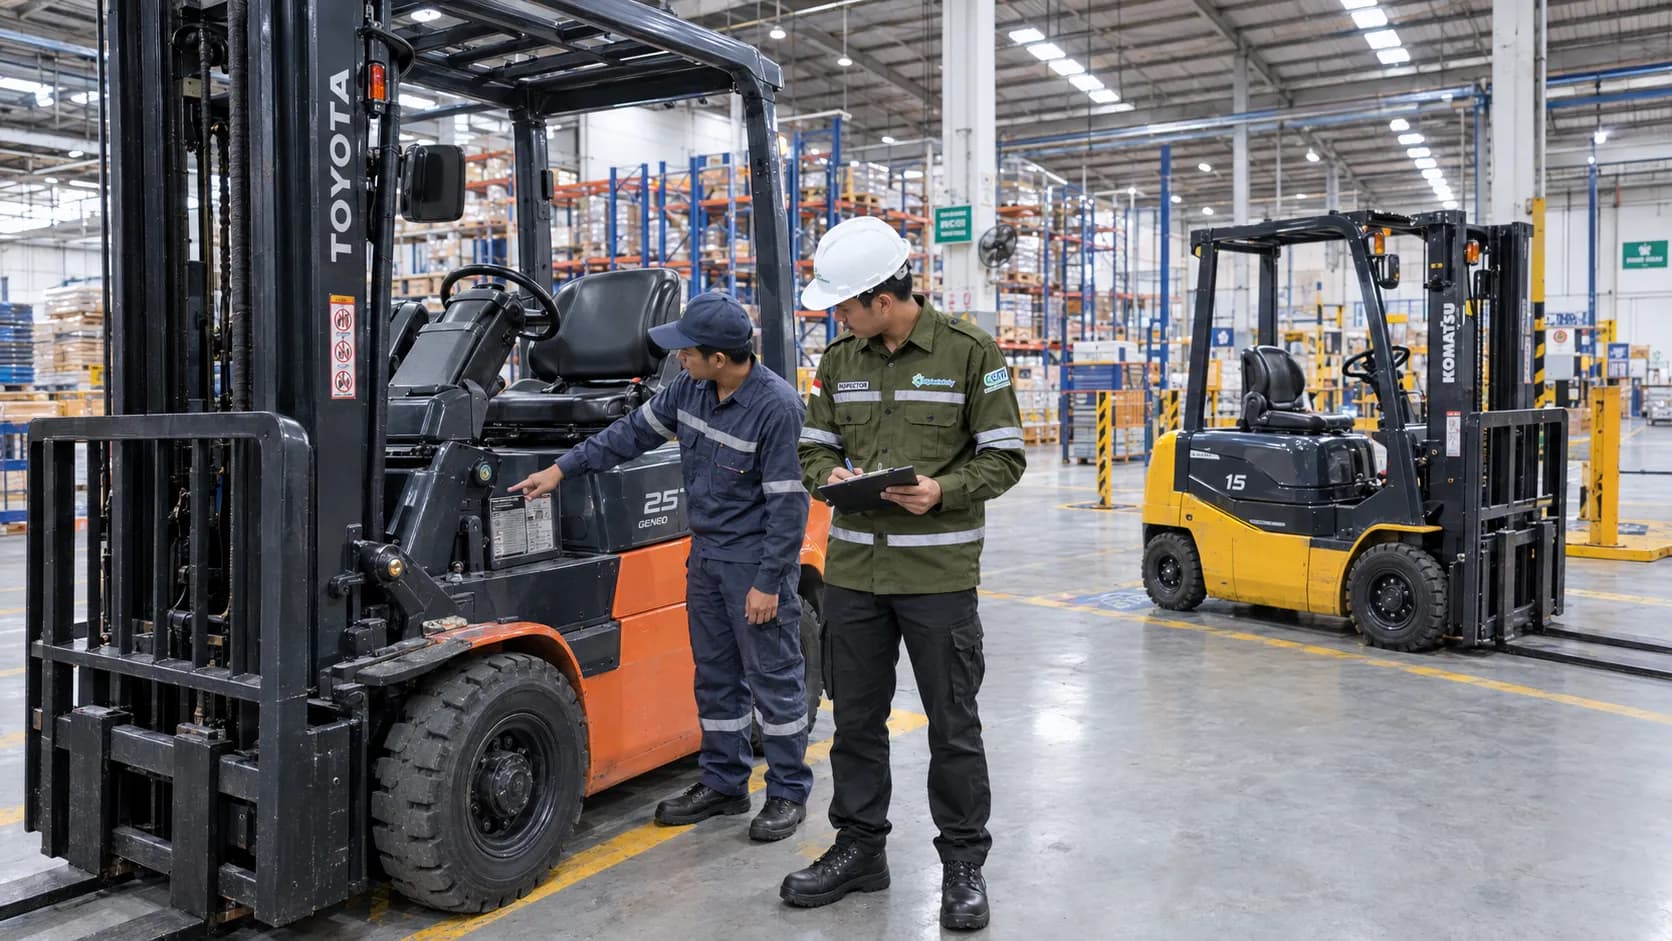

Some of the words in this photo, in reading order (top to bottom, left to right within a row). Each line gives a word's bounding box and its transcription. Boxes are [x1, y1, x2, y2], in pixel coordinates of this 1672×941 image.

[329, 68, 352, 263] TOYOTA
[1440, 302, 1456, 384] KOMATSU
[1225, 473, 1247, 491] 15
[643, 487, 685, 515] 25
[638, 515, 668, 529] GENEO
